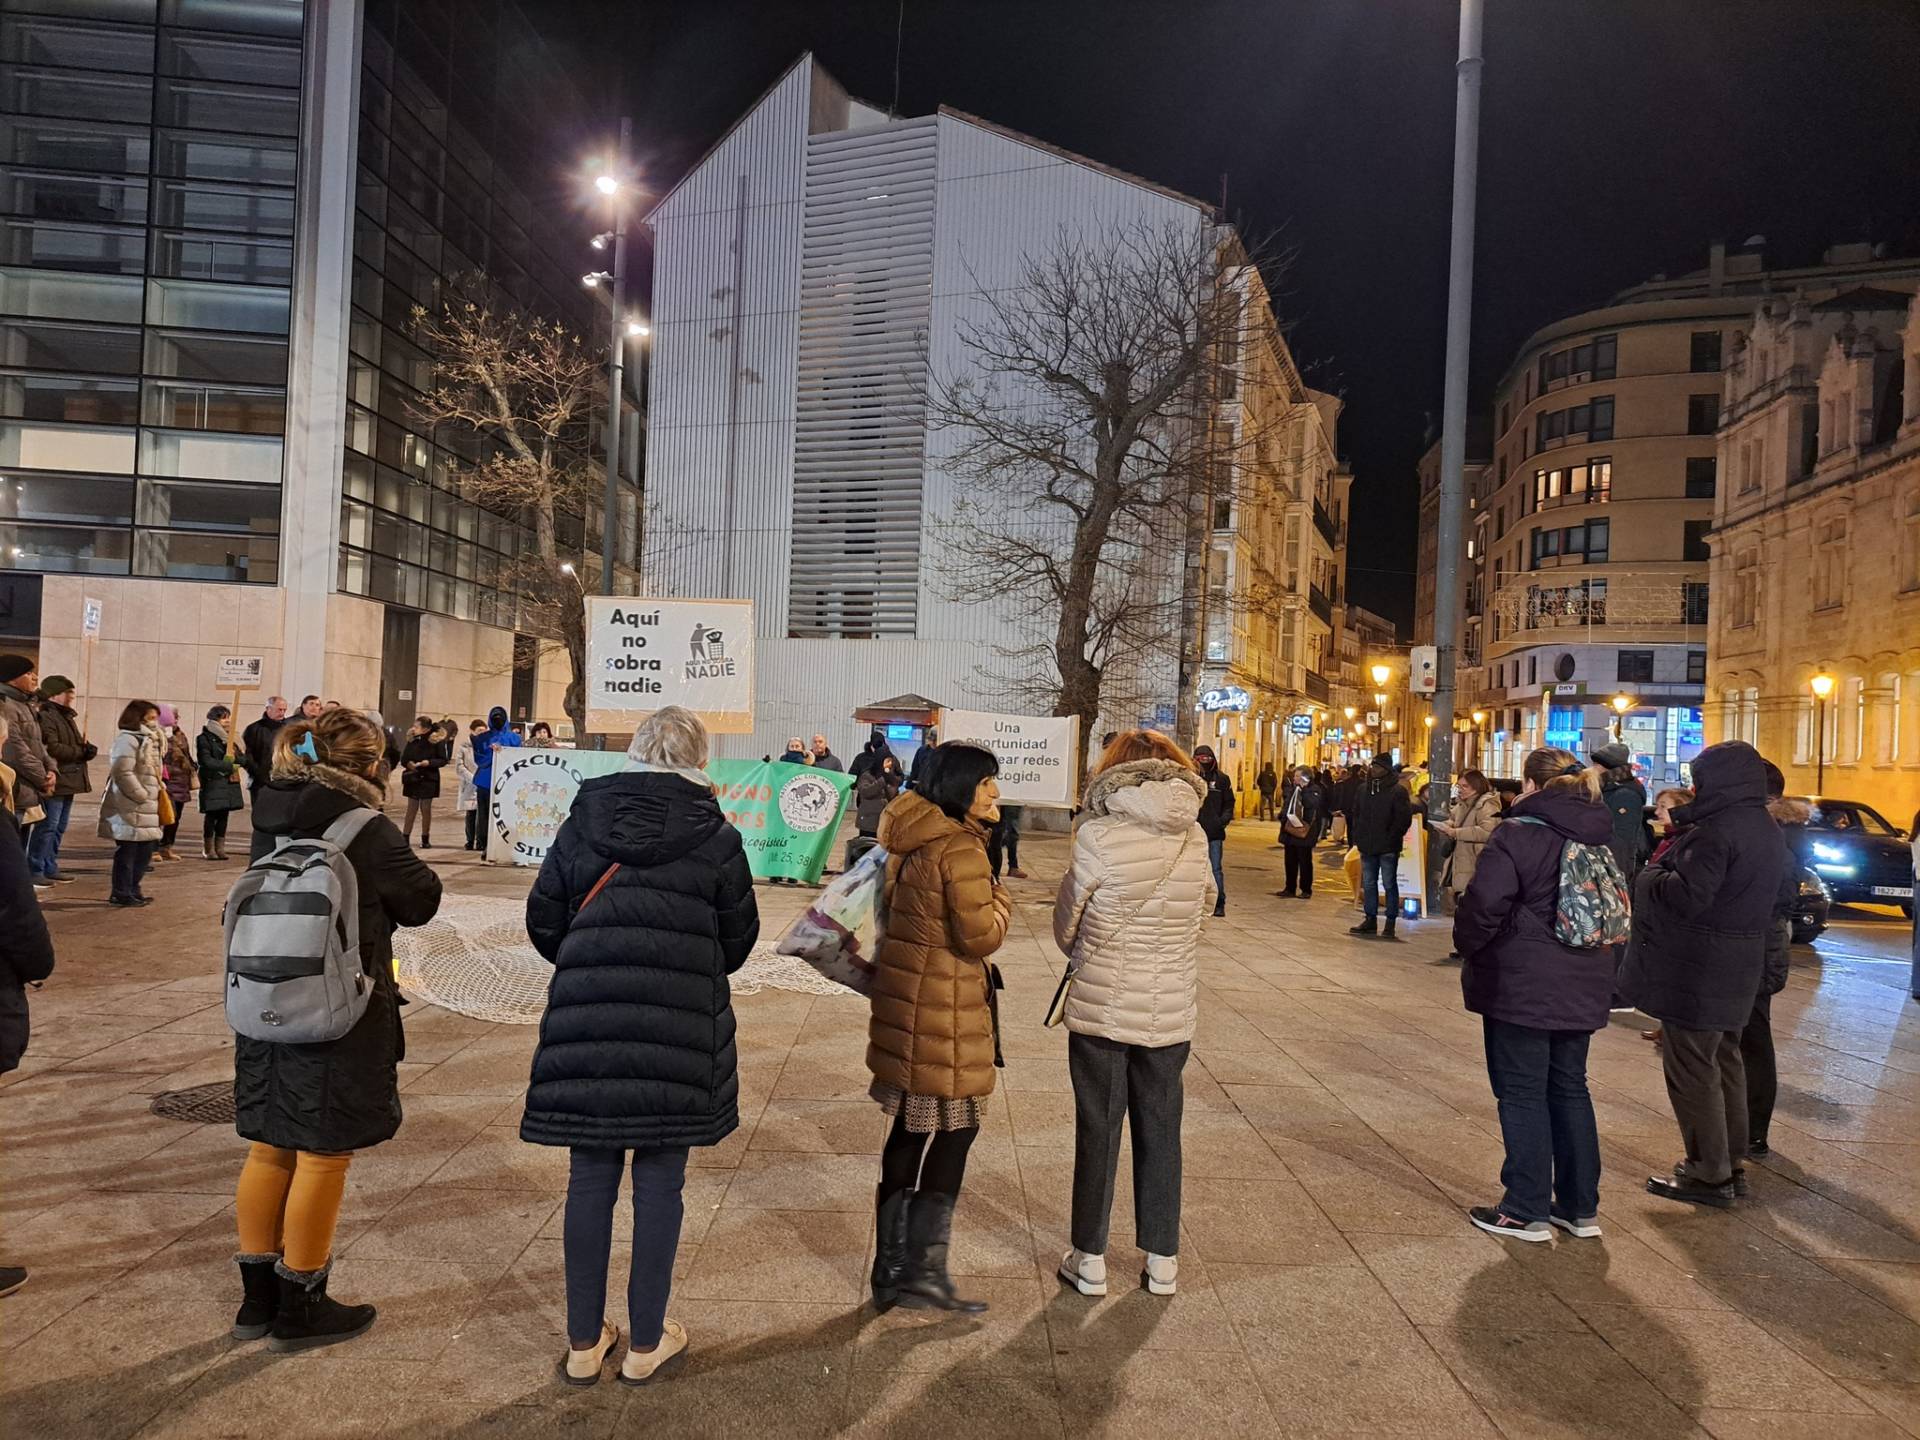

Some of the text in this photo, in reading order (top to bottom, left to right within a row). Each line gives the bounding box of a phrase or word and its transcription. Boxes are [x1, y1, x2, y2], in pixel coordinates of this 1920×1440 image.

[610, 608, 661, 628] Aquí
[622, 636, 647, 648] no
[225, 658, 244, 666] CIES
[606, 654, 661, 671] sobra
[685, 662, 736, 679] NADIE
[605, 677, 662, 693] nadie
[994, 721, 1021, 734] Una
[1023, 755, 1060, 767] redes
[494, 754, 585, 796] CIRCULO
[492, 802, 512, 845] DEL
